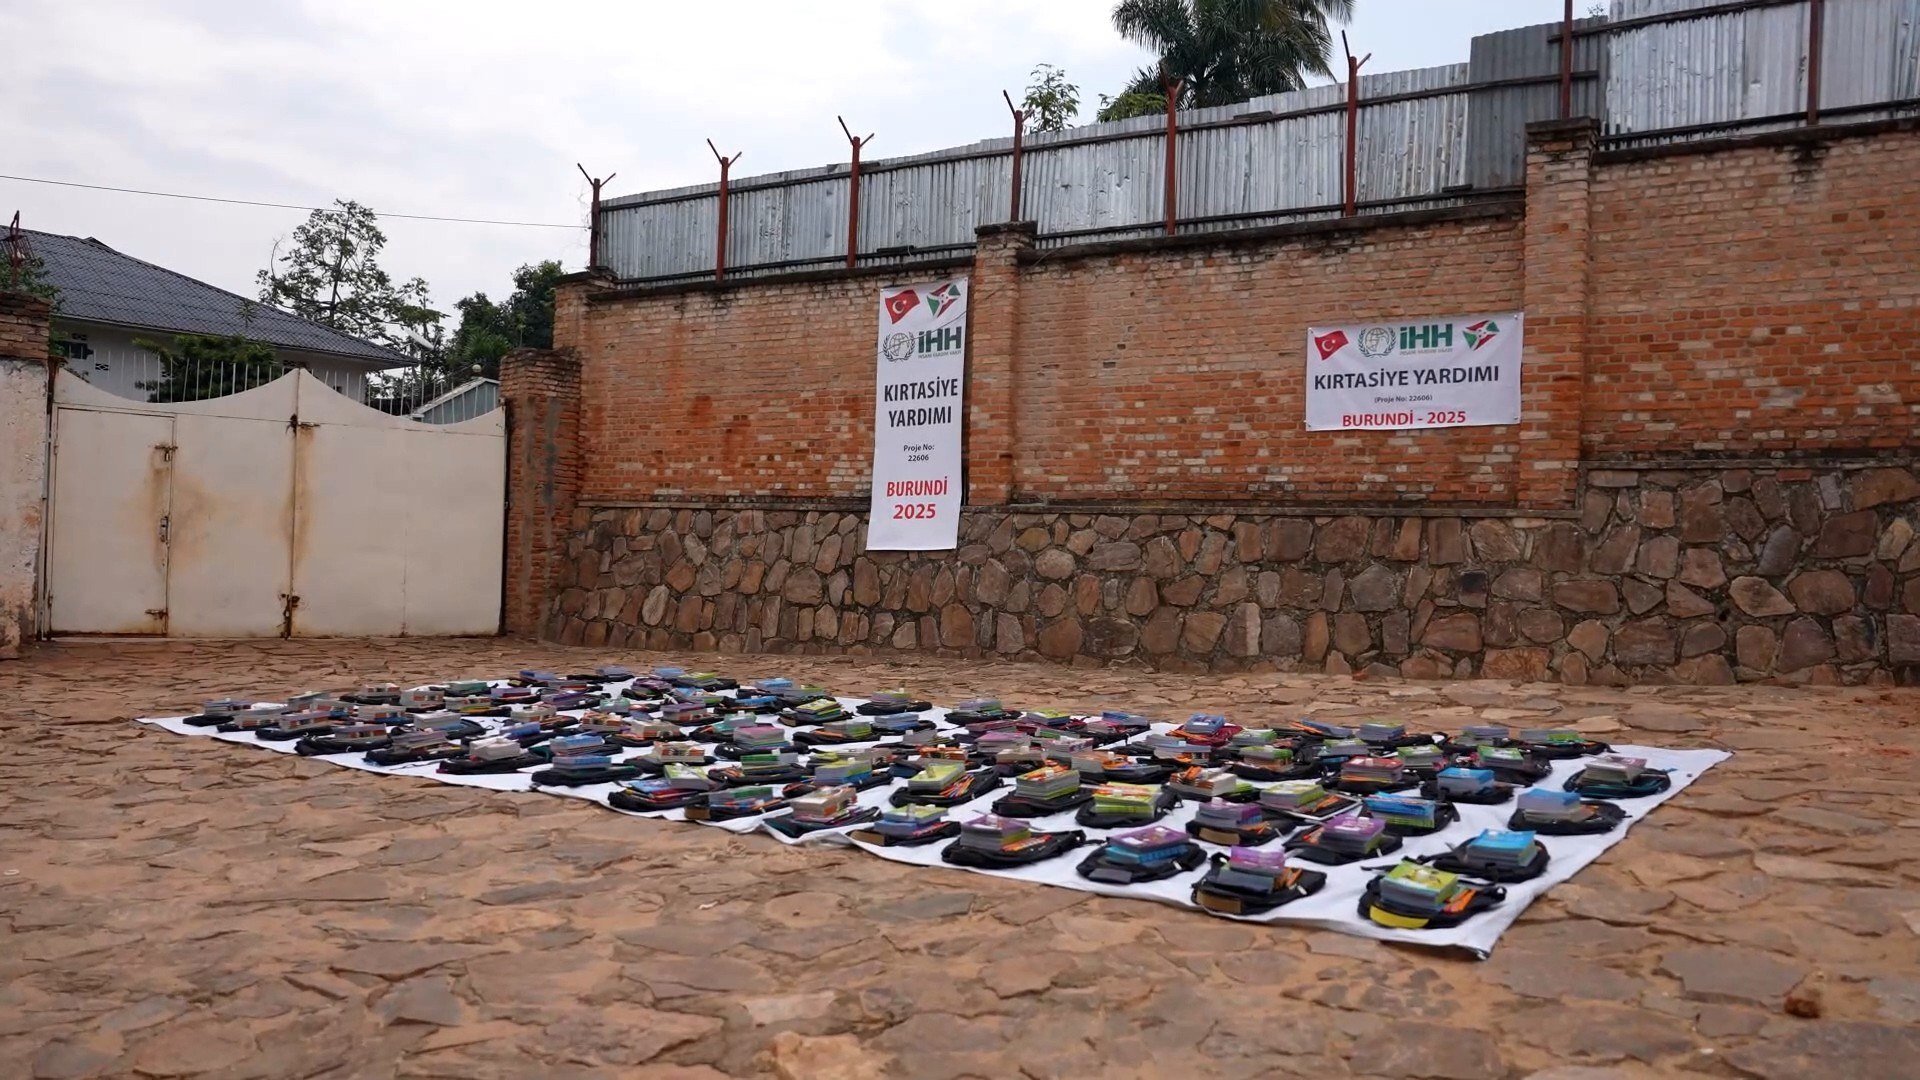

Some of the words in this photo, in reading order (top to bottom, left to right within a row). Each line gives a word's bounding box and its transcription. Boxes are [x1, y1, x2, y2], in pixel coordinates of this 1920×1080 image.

[1314, 368, 1409, 390] KIRTASİYE
[1413, 365, 1499, 385] YARDIMI
[884, 376, 958, 402] KIRTASİYE
[1374, 396, 1395, 404] (Proje
[1395, 394, 1407, 403] No:
[1408, 394, 1433, 402] 22606)
[888, 406, 952, 428] YARDIMI
[1342, 409, 1414, 427] BURUNDİ
[1427, 410, 1466, 424] 2025
[903, 444, 922, 453] Proje
[922, 443, 935, 452] No:
[907, 453, 930, 462] 22606
[886, 475, 948, 497] BURUNDİ
[893, 503, 936, 520] 2025
